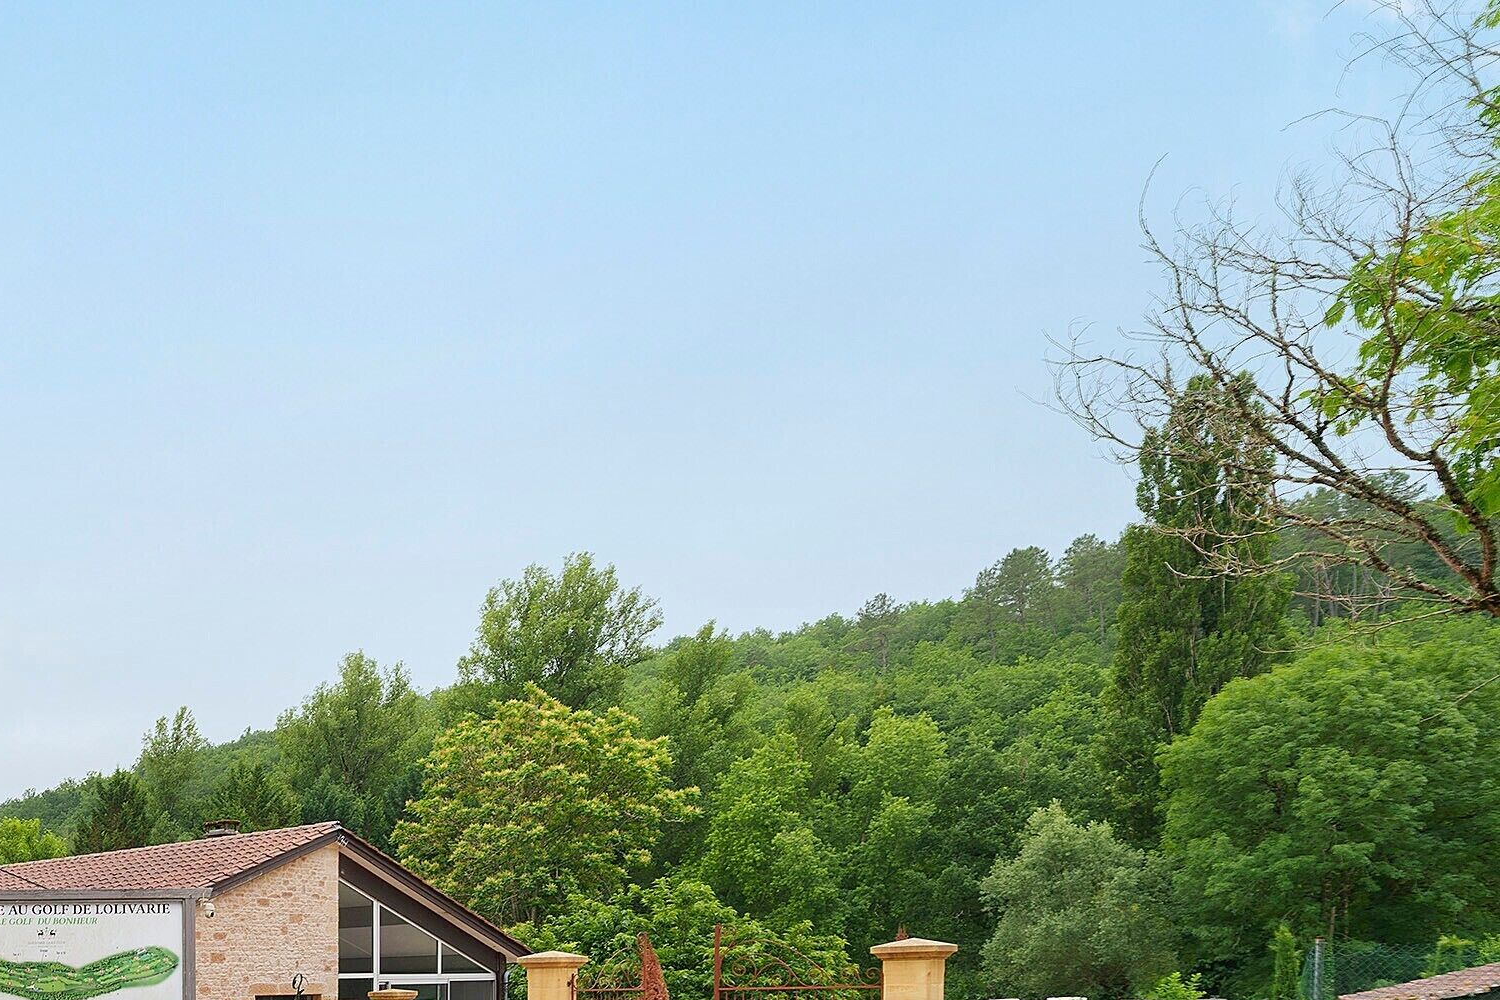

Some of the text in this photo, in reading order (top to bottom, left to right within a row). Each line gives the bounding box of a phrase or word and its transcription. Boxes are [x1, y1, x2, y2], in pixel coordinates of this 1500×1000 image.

[8, 904, 29, 916] AU
[31, 903, 70, 916] GOLF
[73, 903, 92, 915] DE
[95, 902, 171, 915] LOLIVARIE
[8, 917, 33, 926] GOLF
[36, 917, 51, 925] DU
[52, 916, 99, 925] BONHEUR
